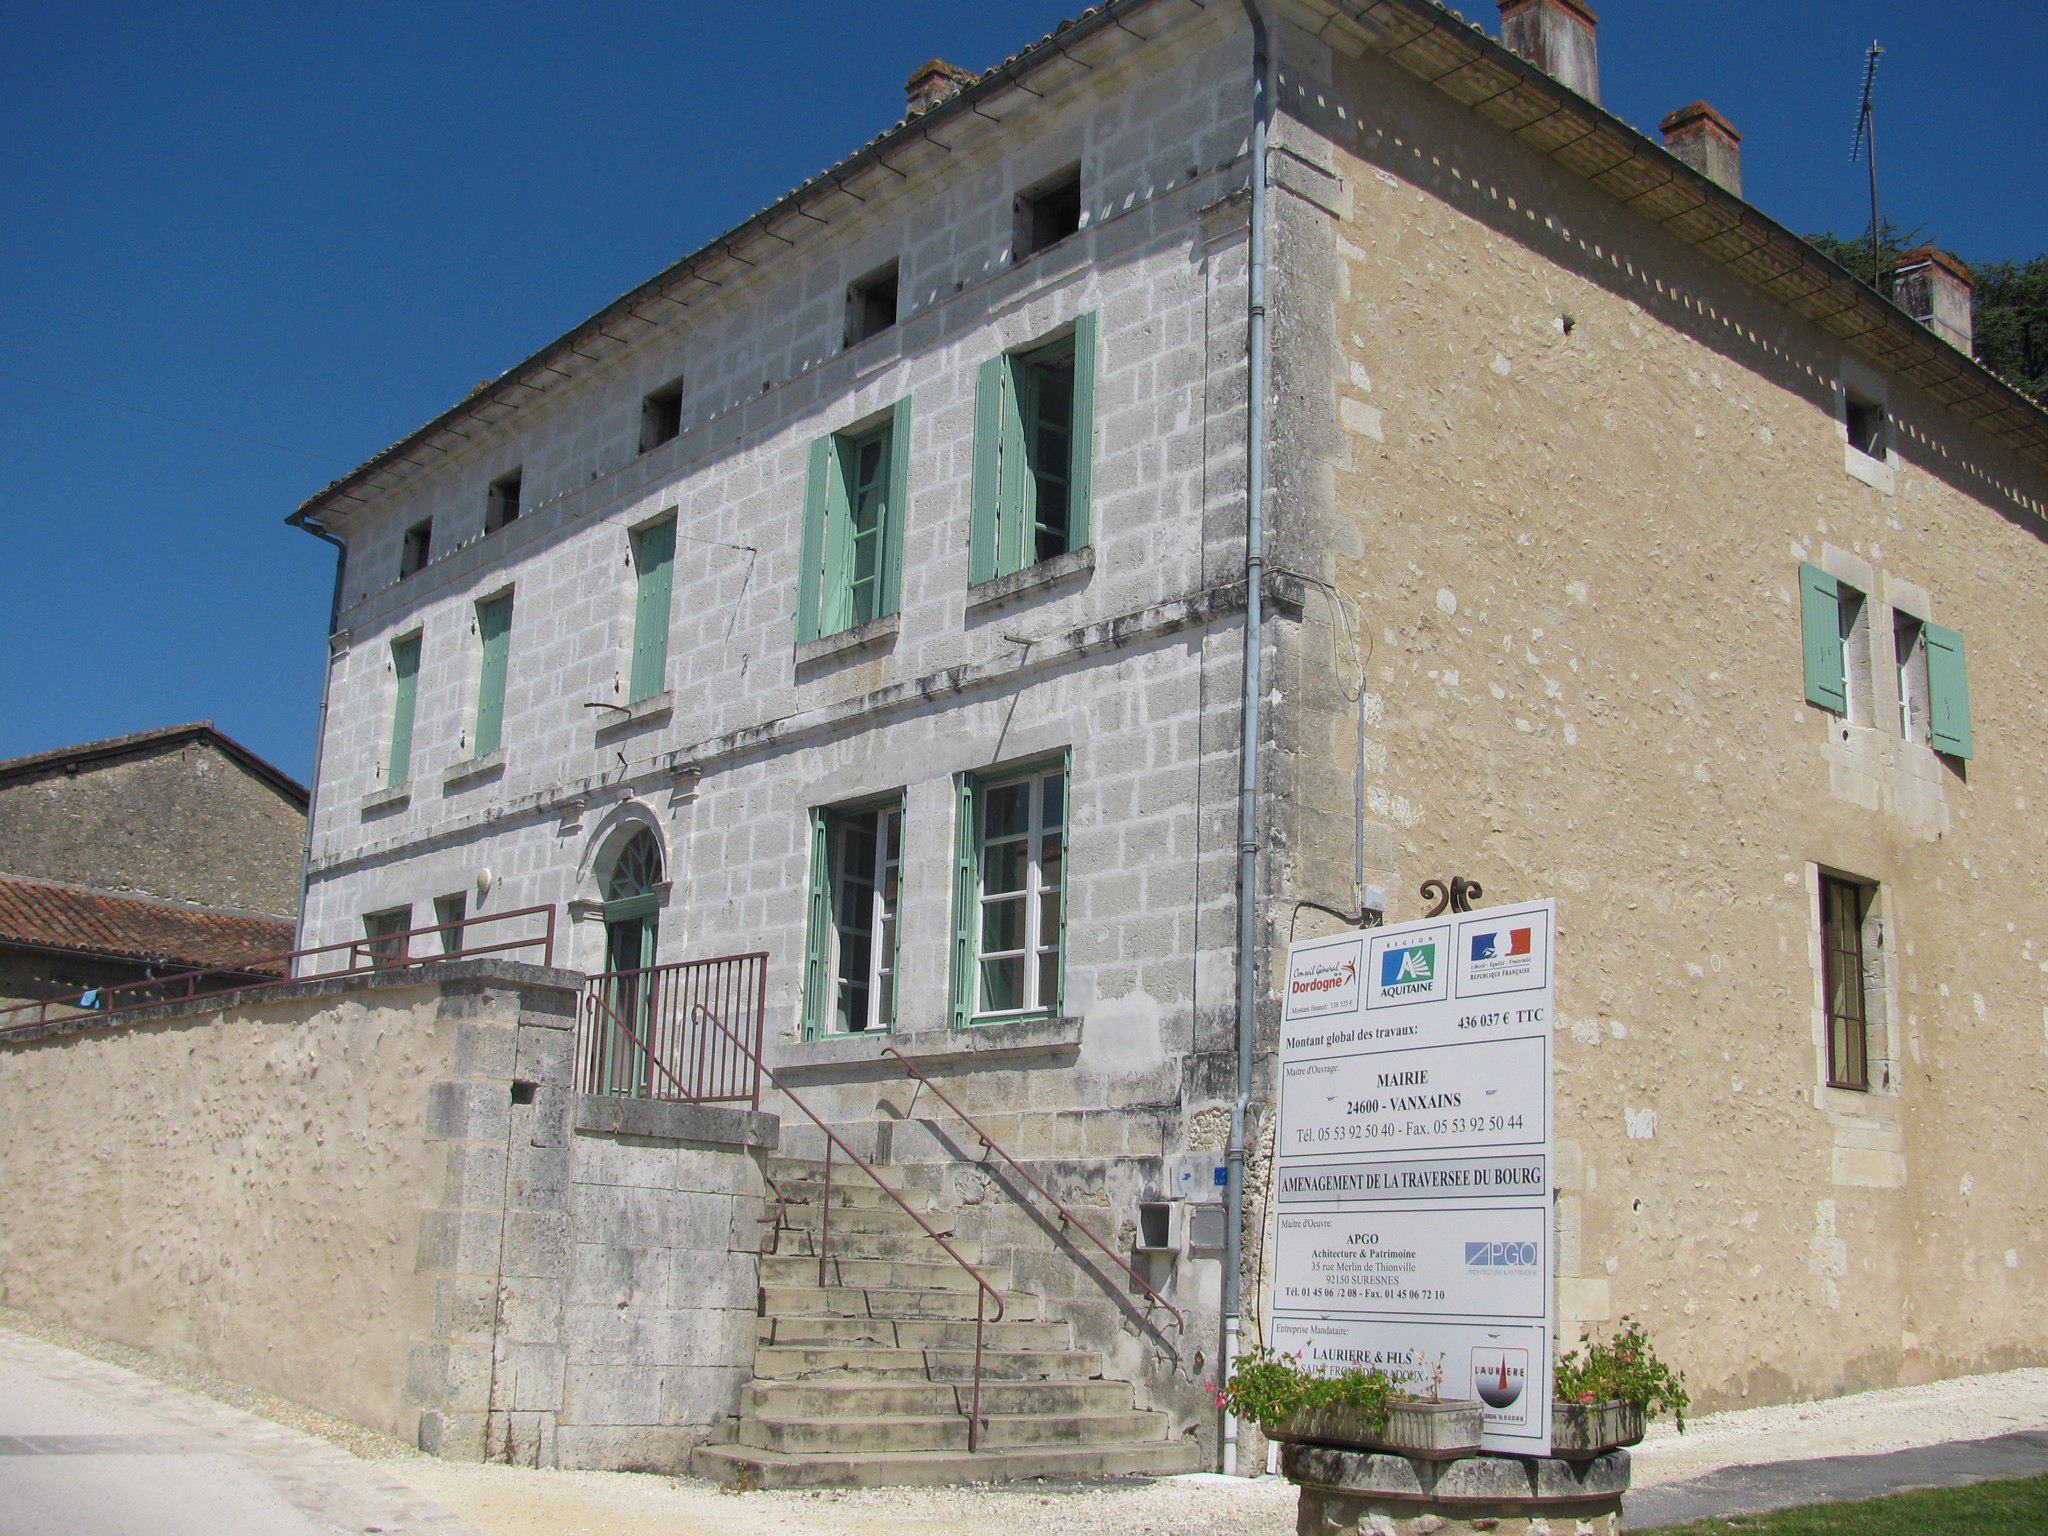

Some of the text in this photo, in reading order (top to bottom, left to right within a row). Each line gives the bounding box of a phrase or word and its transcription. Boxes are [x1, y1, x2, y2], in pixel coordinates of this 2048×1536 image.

[1293, 961, 1340, 978] Conseil Général
[1292, 977, 1343, 994] Dordogne
[1381, 981, 1433, 998] AQUITAINE
[1457, 1008, 1544, 1029] 436 037 € TTC
[1286, 1025, 1418, 1049] Montant global des travaux:
[1377, 1070, 1429, 1088] MAIRIE
[1347, 1099, 1379, 1115] 24600
[1389, 1093, 1461, 1111] VANXAINS
[1296, 1128, 1315, 1143] Tél.
[1318, 1127, 1330, 1141] 05
[1333, 1126, 1346, 1141] 53
[1349, 1125, 1362, 1139] 92
[1365, 1124, 1378, 1139] 50
[1381, 1122, 1395, 1137] 40
[1406, 1121, 1430, 1136] Fax.
[1433, 1119, 1448, 1134] 05
[1452, 1118, 1466, 1133] 53
[1470, 1117, 1484, 1132] 92
[1489, 1115, 1504, 1131] 50
[1507, 1114, 1523, 1129] 44
[1281, 1167, 1541, 1192] AMENAGEMENT DE LA TRAVERSEE DU BOURG
[1346, 1233, 1379, 1245] APGO
[1312, 1248, 1416, 1259] Achitecture & Patrimoine
[1465, 1242, 1536, 1266] APGO
[1311, 1261, 1320, 1271] 35
[1336, 1261, 1362, 1272] Merlin
[1363, 1262, 1373, 1272] de
[1374, 1262, 1416, 1272] Thionville
[1325, 1275, 1399, 1285] 92150 SURESNES
[1285, 1287, 1300, 1296] Tél.
[1301, 1287, 1310, 1296] 01
[1313, 1288, 1323, 1297] 45
[1324, 1288, 1334, 1297] 06
[1347, 1288, 1357, 1298] 08
[1364, 1289, 1382, 1298] Fax.
[1384, 1289, 1394, 1299] 01
[1397, 1289, 1407, 1299] 45
[1409, 1290, 1420, 1299] 06
[1422, 1290, 1432, 1300] 72
[1434, 1290, 1445, 1300] 10
[1276, 1323, 1349, 1336] Entreprise Mandataire:
[1313, 1348, 1412, 1365] LAURIERE & FILS
